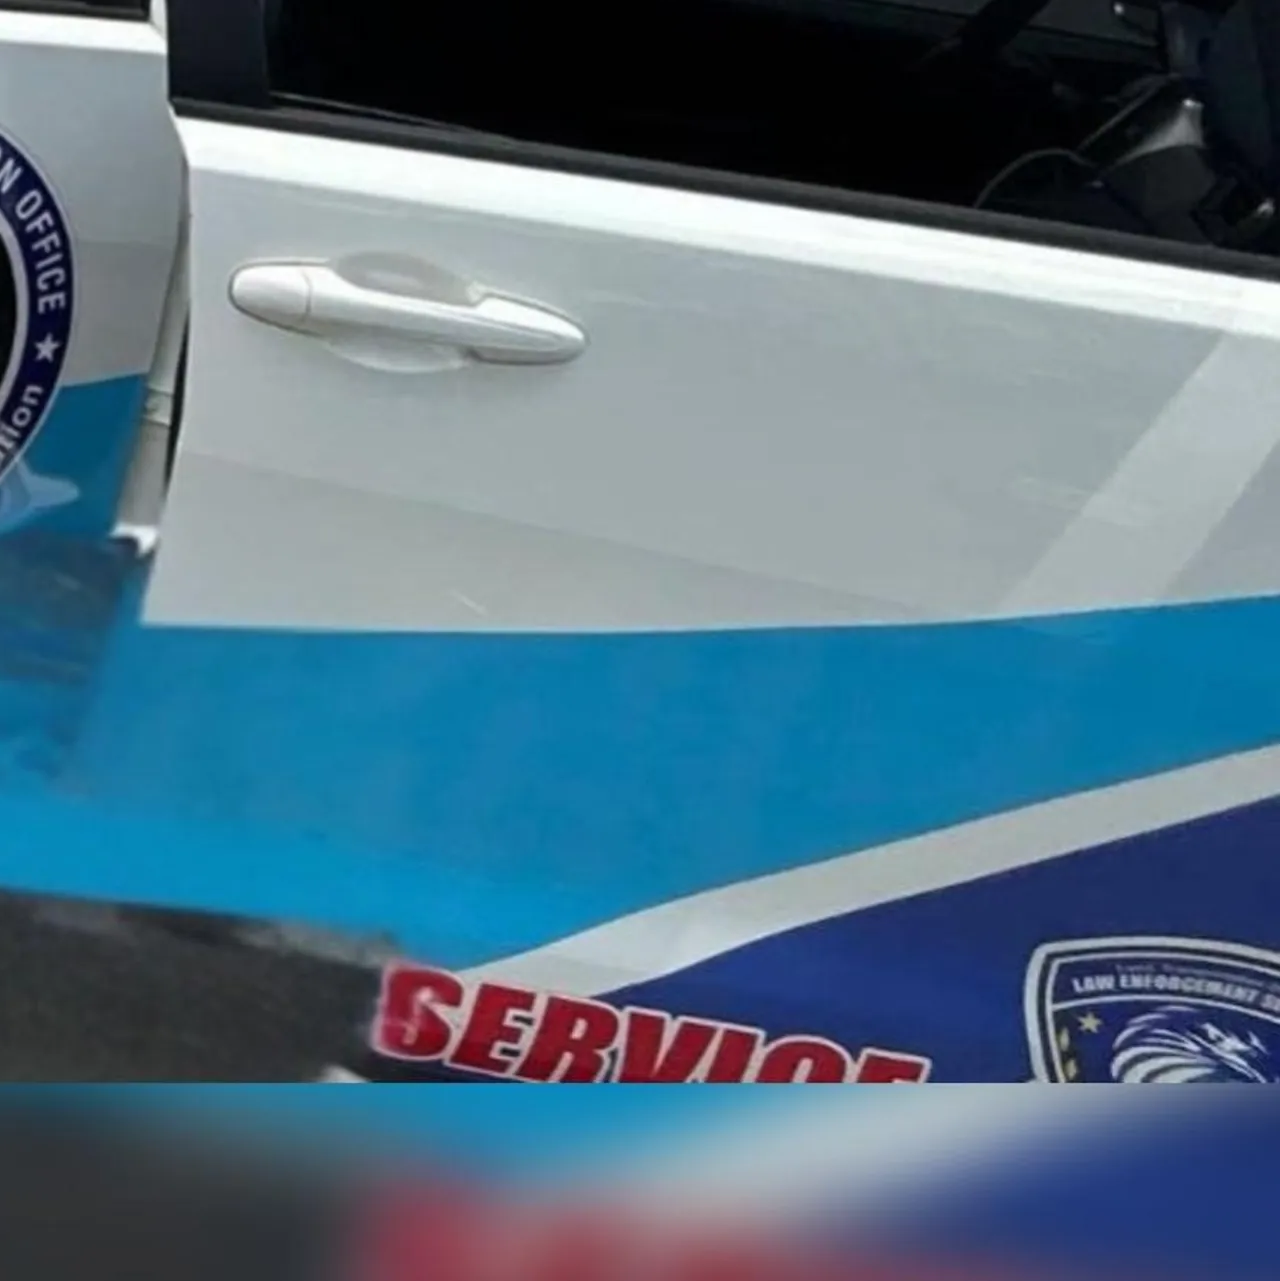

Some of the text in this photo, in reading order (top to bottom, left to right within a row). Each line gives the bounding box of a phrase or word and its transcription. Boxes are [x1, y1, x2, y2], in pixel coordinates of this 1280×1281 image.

[14, 188, 67, 314] OFFICE
[1072, 973, 1115, 993] LAW
[1119, 973, 1260, 1003] ENFORCEMENT
